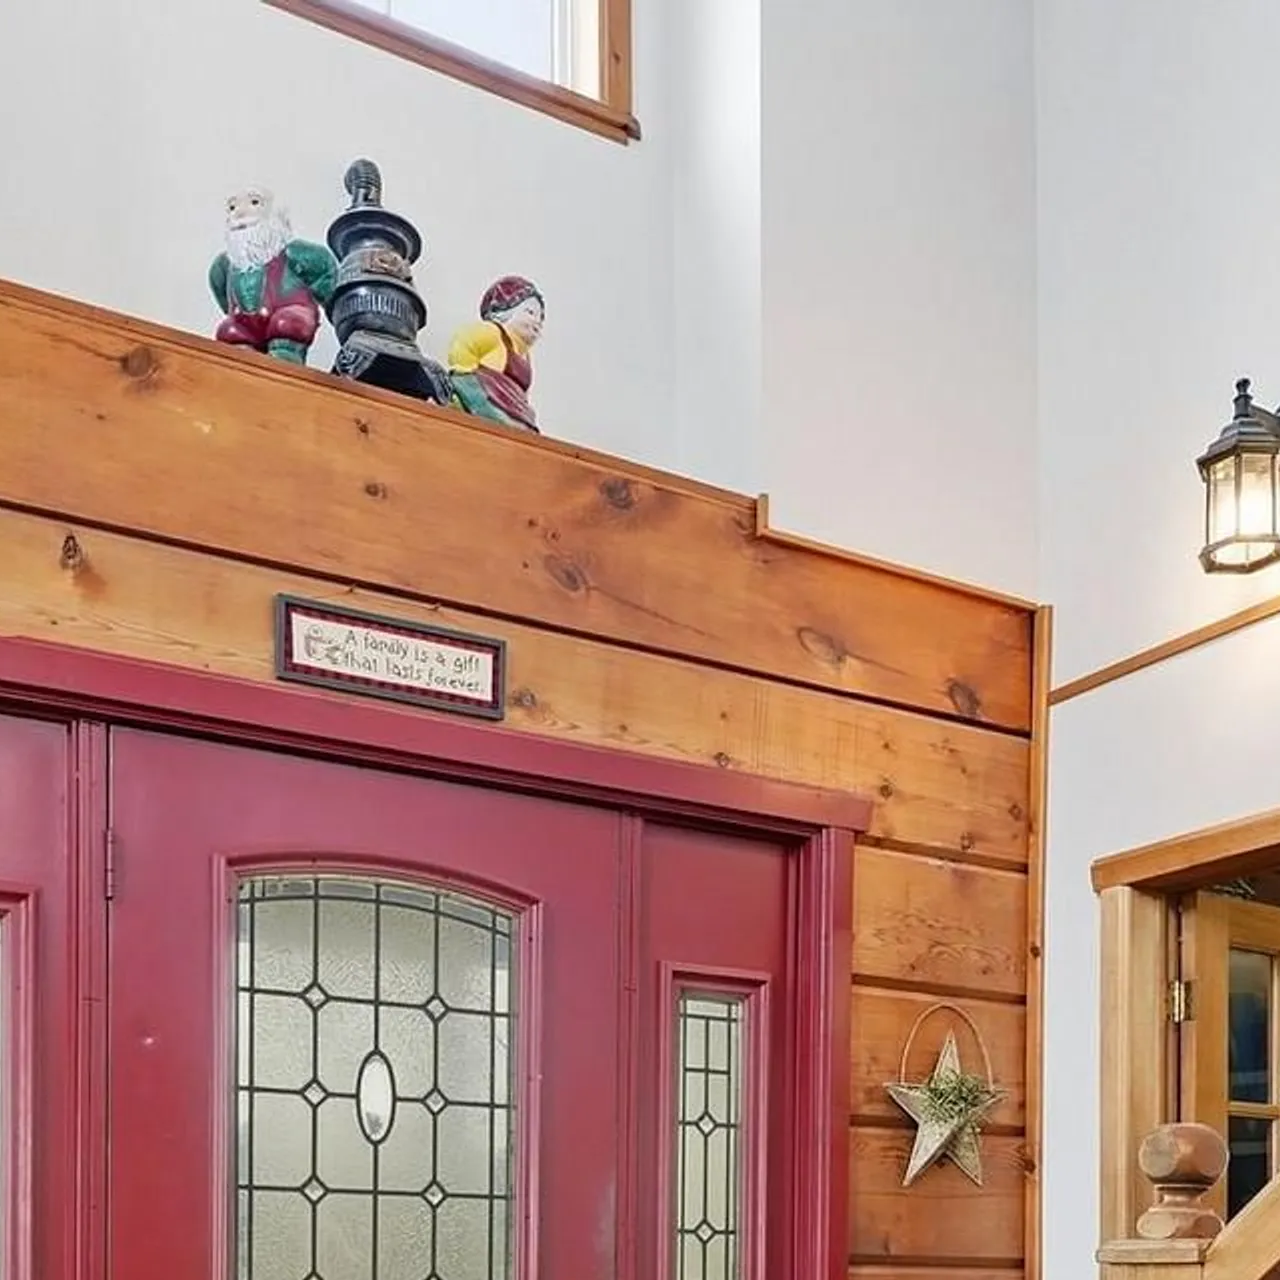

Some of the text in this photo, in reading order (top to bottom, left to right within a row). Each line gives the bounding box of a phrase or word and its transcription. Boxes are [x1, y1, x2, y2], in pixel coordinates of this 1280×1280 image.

[344, 651, 378, 673] that
[386, 657, 422, 680] lasts
[345, 630, 480, 673] A family is a gift
